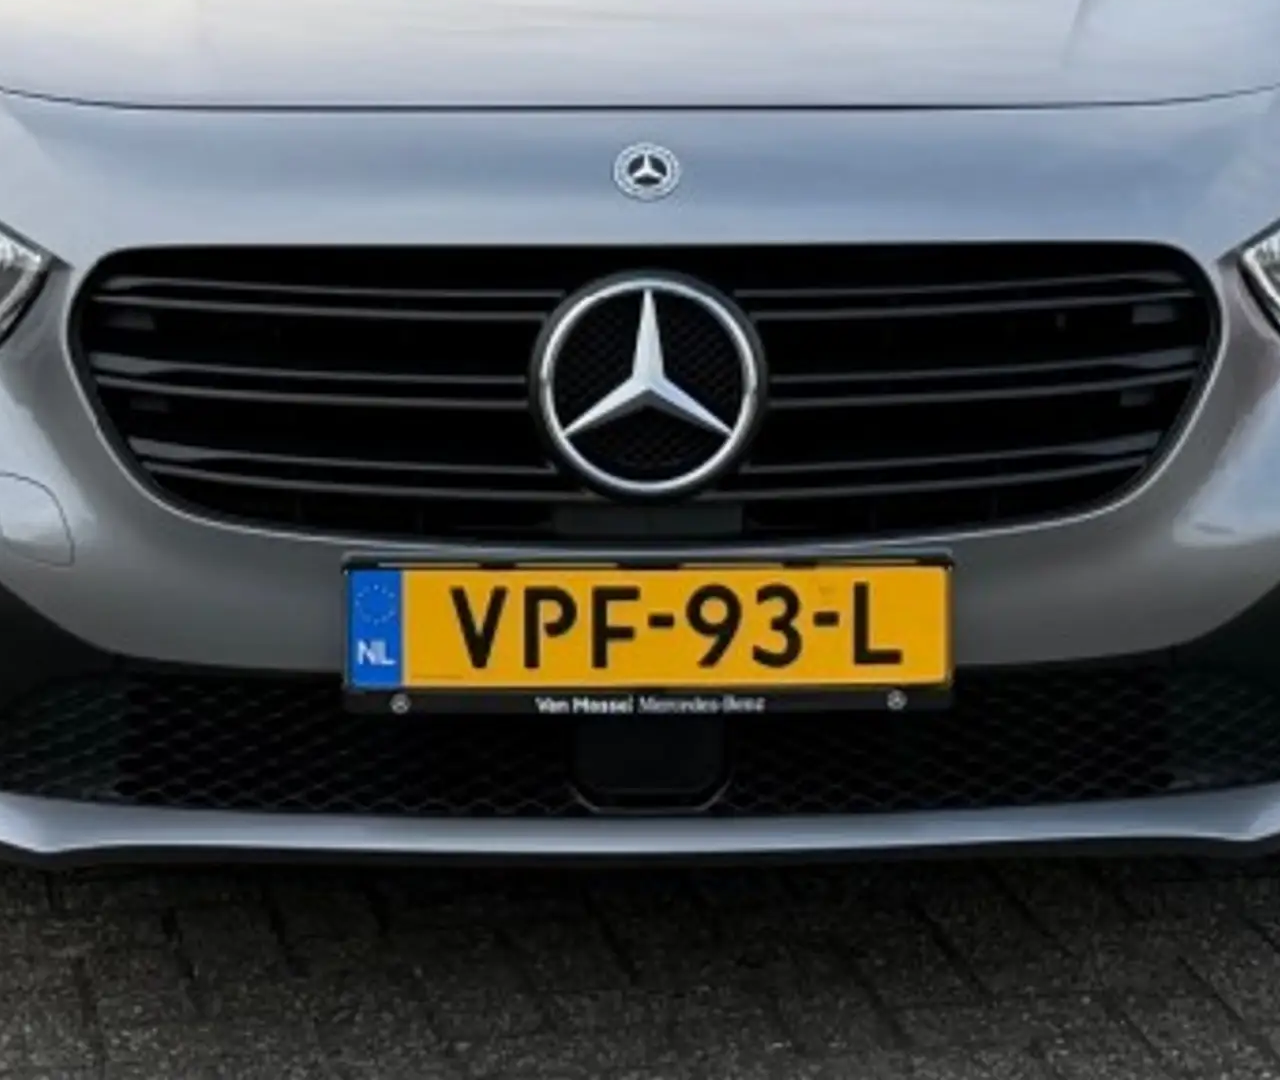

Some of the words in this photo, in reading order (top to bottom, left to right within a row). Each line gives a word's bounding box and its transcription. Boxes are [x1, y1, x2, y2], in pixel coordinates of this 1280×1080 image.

[449, 581, 904, 670] VPF-93-L
[357, 640, 397, 665] NL
[534, 696, 570, 714] Van
